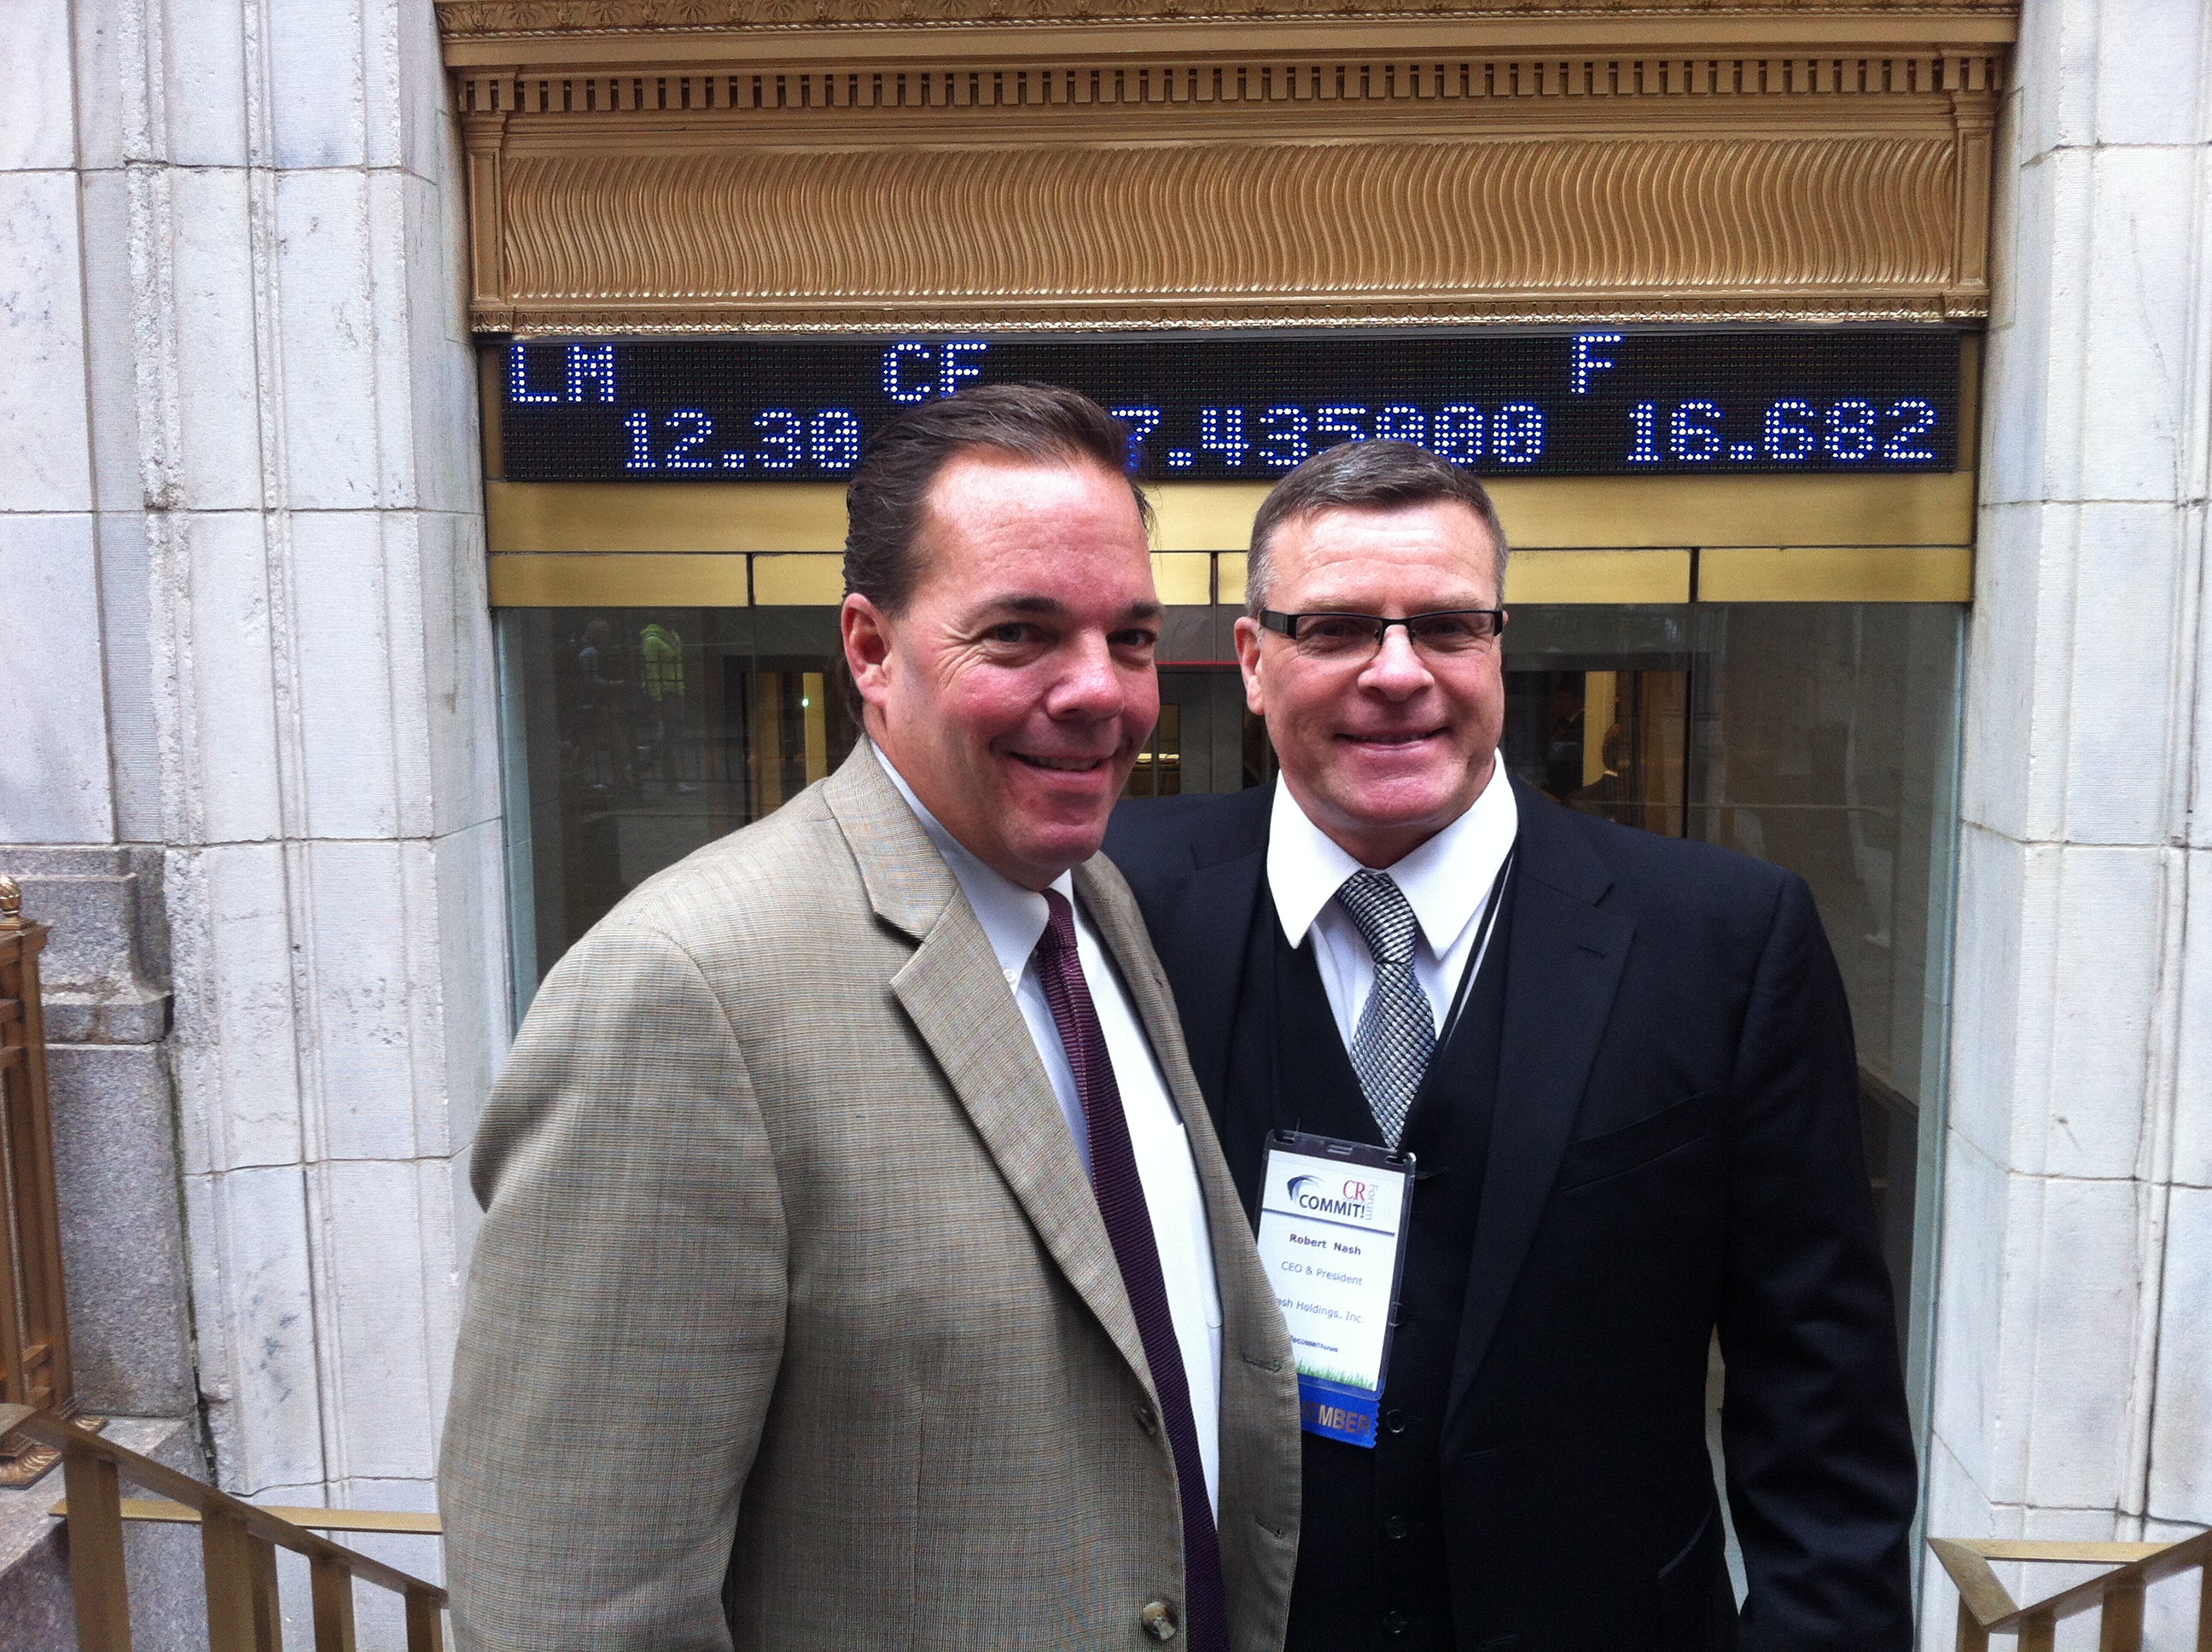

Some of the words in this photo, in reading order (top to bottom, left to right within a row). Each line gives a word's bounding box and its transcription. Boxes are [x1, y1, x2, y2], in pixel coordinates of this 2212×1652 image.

[512, 344, 615, 403] LM
[1570, 334, 1621, 394] F
[625, 410, 859, 469] 12.30
[1627, 399, 1936, 462] 16.682
[1342, 1179, 1366, 1201] CR
[1365, 1184, 1379, 1221] Forum
[1299, 1194, 1365, 1219] COMMIT!
[1289, 1233, 1328, 1249] Robert
[1333, 1242, 1362, 1256] Nash
[1281, 1260, 1303, 1274] CEO
[1305, 1265, 1313, 1275] &
[1316, 1268, 1363, 1286] President
